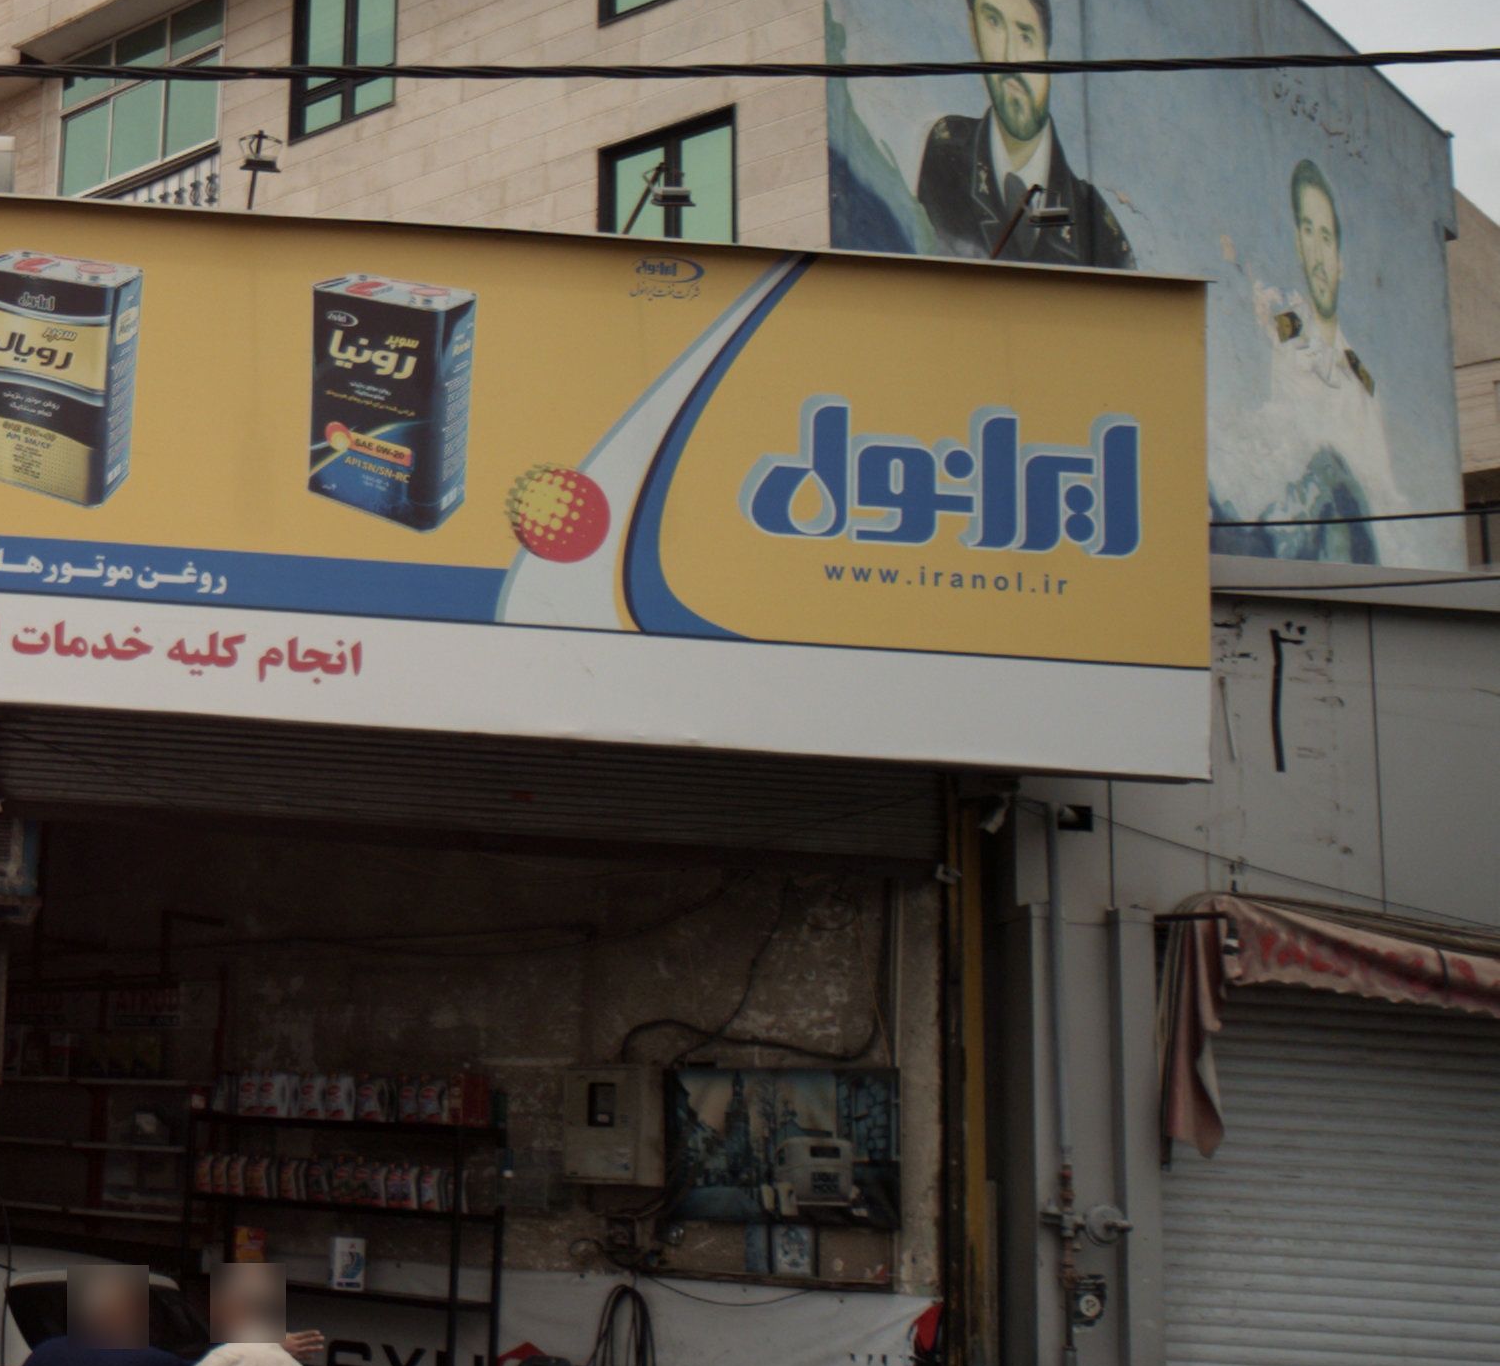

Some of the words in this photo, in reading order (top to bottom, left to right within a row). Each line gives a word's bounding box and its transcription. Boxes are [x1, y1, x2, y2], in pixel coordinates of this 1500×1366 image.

[327, 329, 419, 380] رونیا
[385, 334, 420, 350] سوپر
[355, 438, 374, 451] SAE
[739, 394, 1141, 558] ایرانول
[135, 561, 228, 595] روغن
[823, 562, 1069, 596] www.iranol.ir
[11, 619, 153, 662] خدمات
[165, 631, 247, 677] کلیه
[257, 636, 364, 685] انجام
